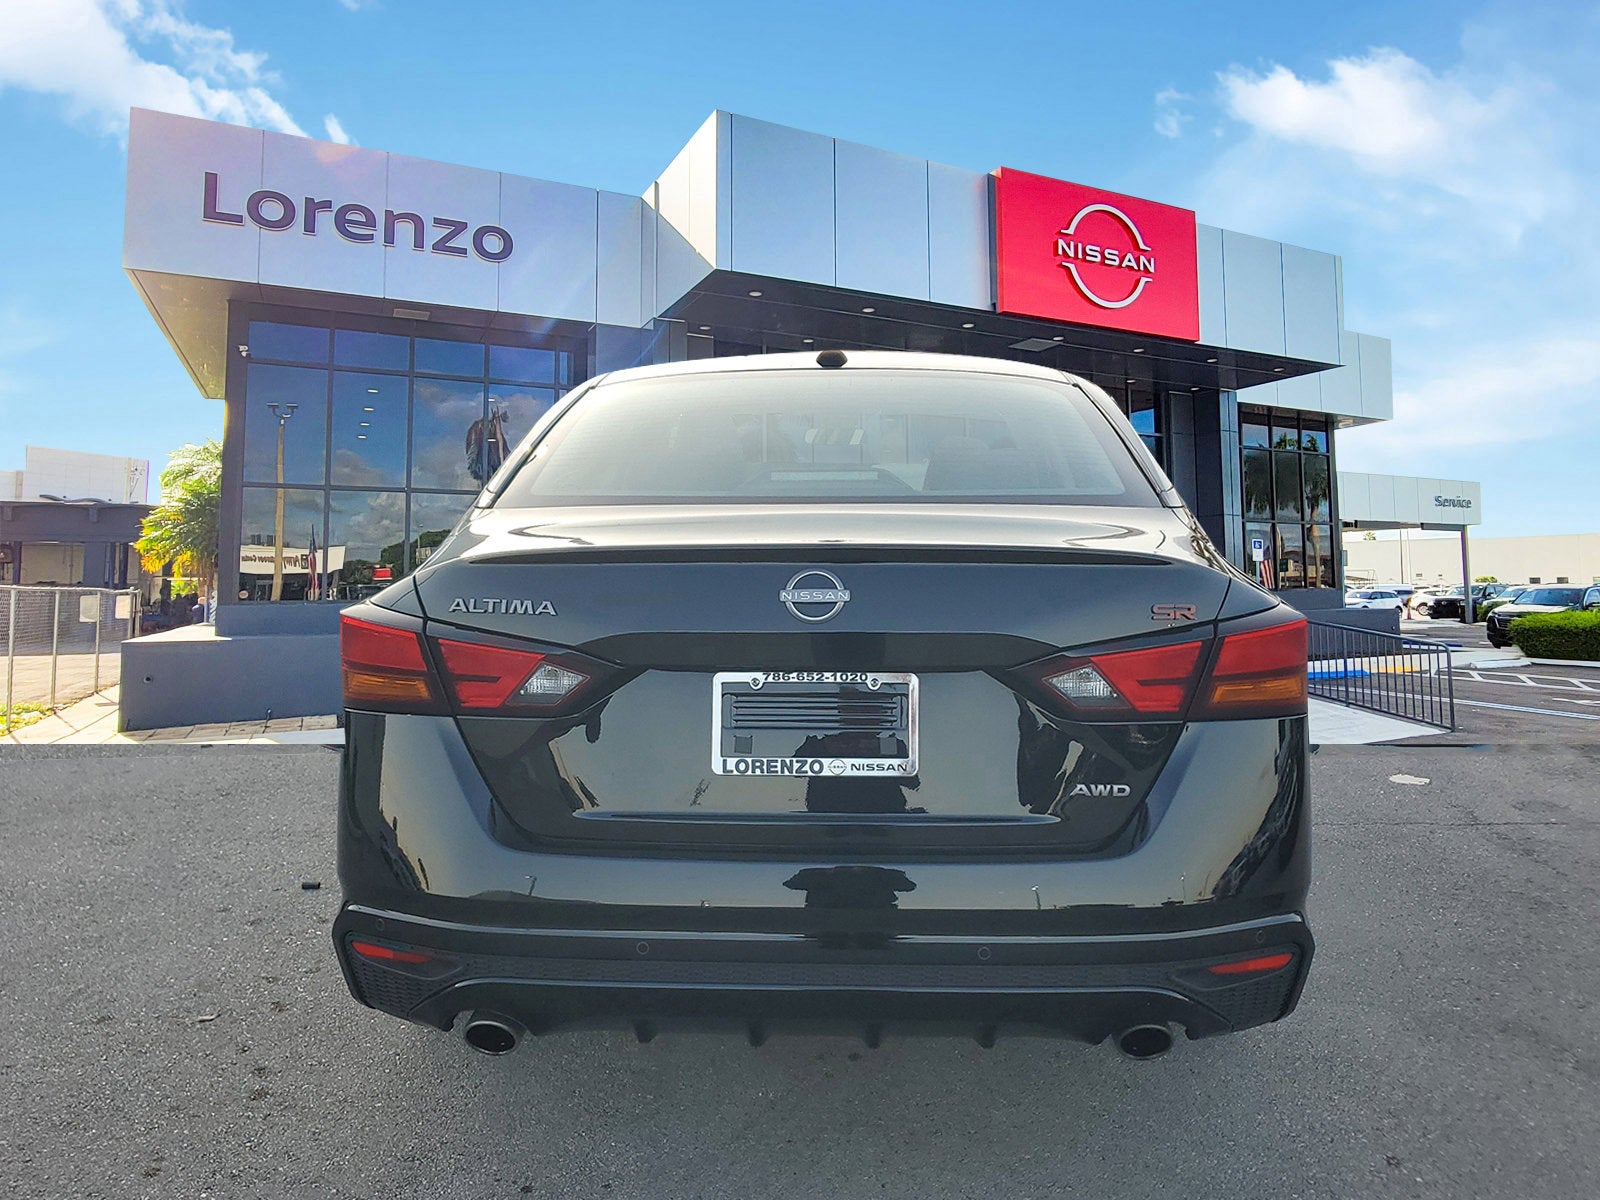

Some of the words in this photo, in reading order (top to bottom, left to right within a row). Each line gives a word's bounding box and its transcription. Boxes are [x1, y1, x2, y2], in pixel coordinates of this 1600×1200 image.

[202, 171, 514, 262] Lorenzo
[1057, 238, 1155, 273] NISSAN
[1434, 495, 1472, 509] Service
[782, 591, 849, 600] NISSAN
[448, 598, 558, 616] ALTIMA
[1151, 604, 1197, 621] SR
[762, 671, 869, 682] 786-652-1020
[722, 758, 825, 775] LORENZO
[850, 763, 908, 772] NISSAN
[1069, 783, 1131, 797] AWD
